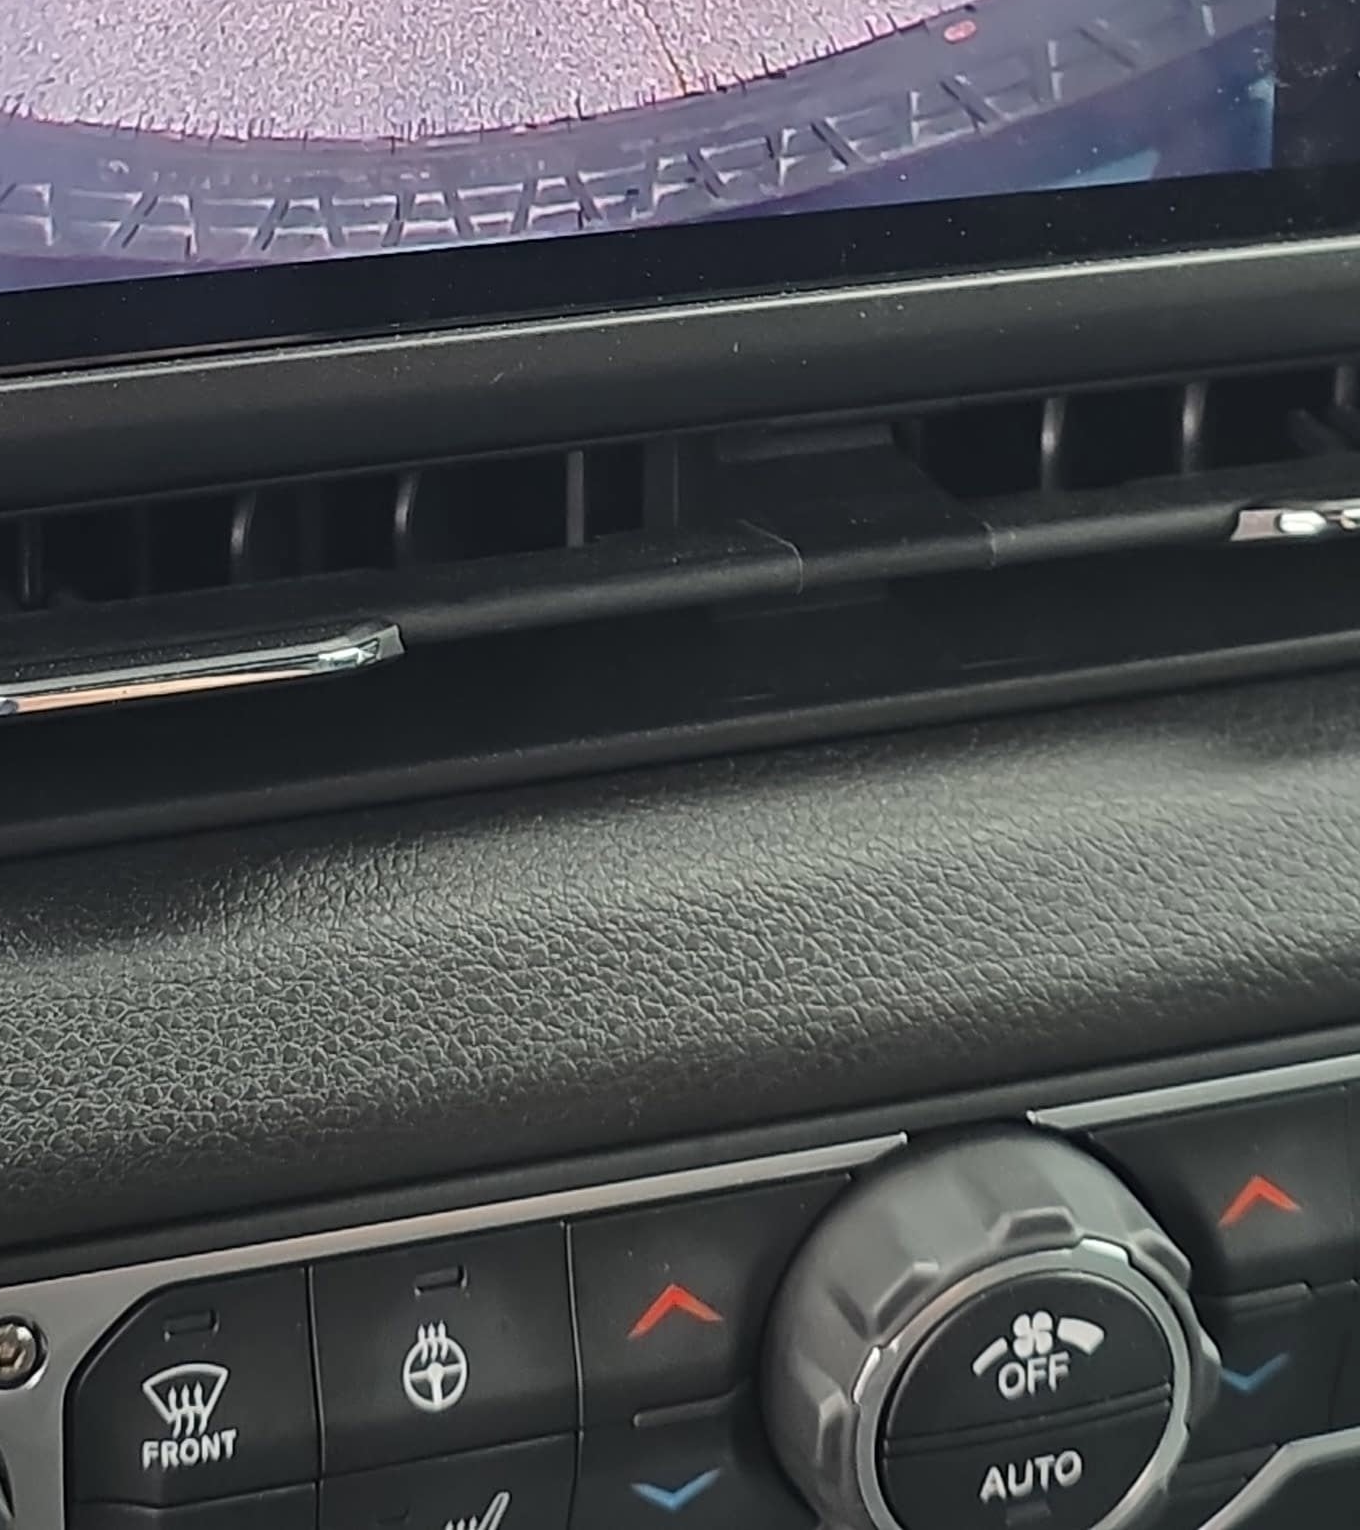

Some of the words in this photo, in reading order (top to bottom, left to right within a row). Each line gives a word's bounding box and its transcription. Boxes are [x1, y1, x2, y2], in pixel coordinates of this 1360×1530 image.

[998, 1353, 1070, 1400] OFF
[142, 1429, 238, 1469] FRONT
[979, 1449, 1083, 1504] AUTO
